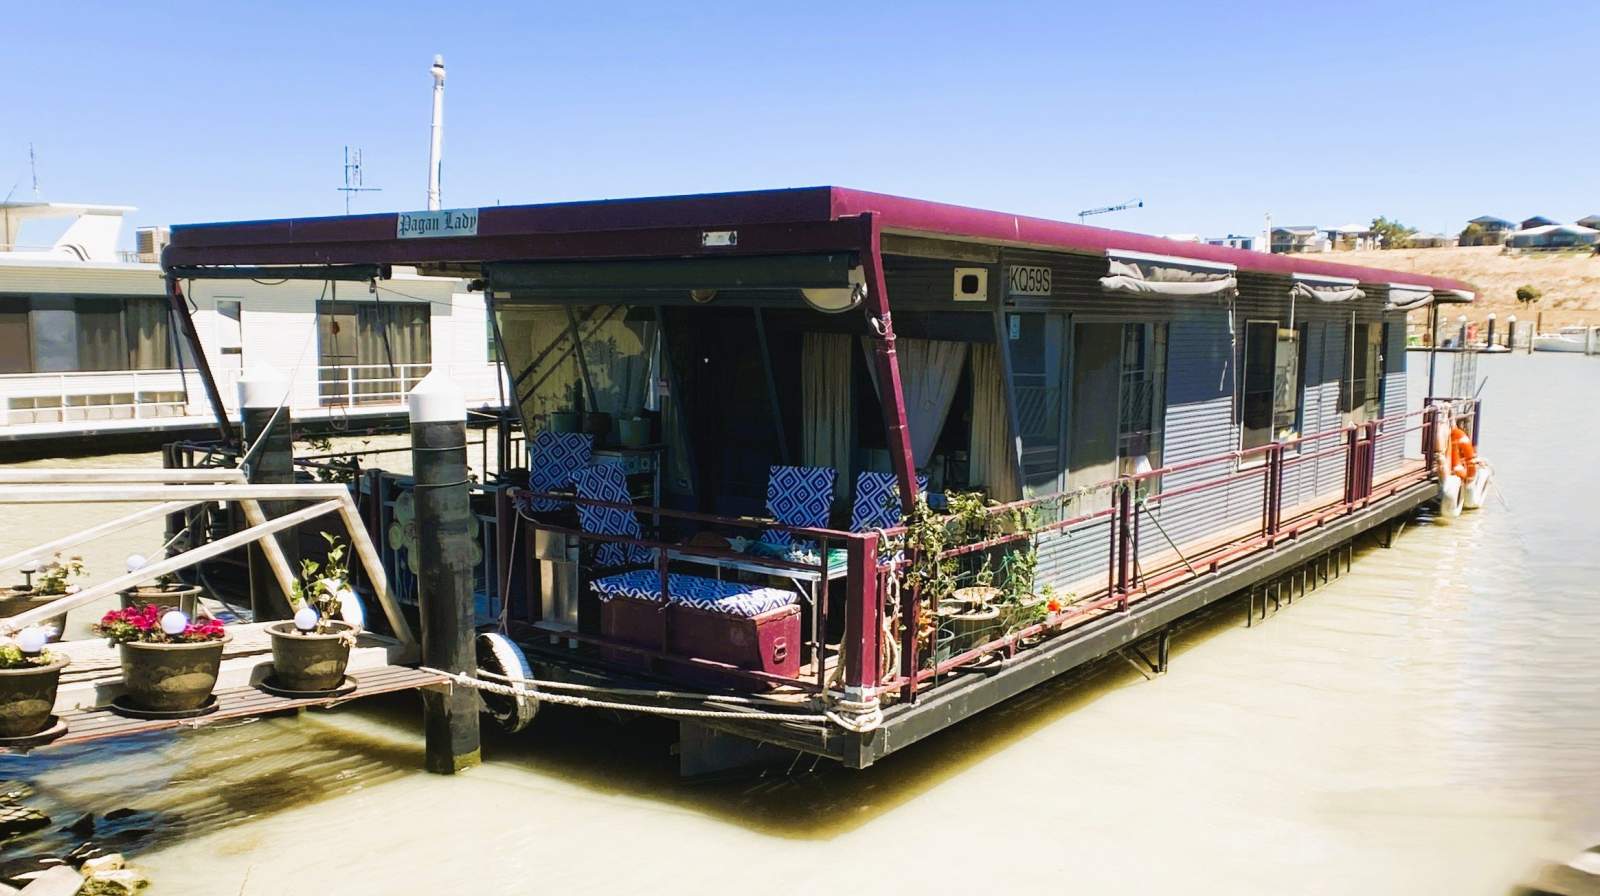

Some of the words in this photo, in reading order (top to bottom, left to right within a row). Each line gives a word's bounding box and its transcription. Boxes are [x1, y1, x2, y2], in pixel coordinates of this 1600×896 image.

[399, 214, 439, 235] Pagan
[443, 211, 477, 232] Lady
[1010, 267, 1050, 292] KQ59S
